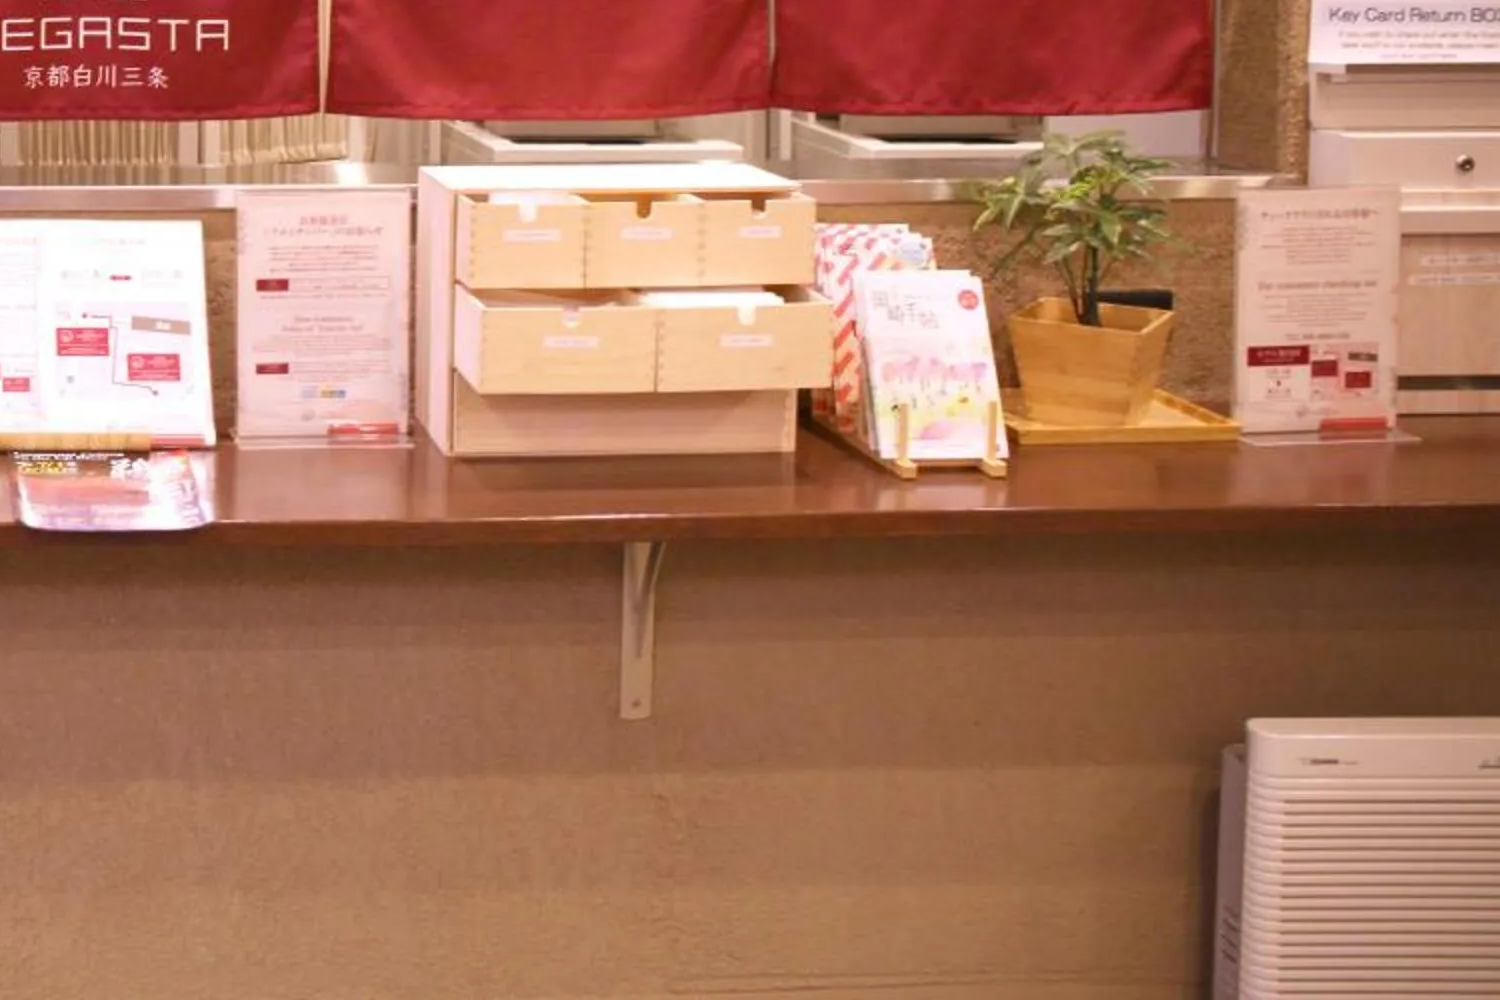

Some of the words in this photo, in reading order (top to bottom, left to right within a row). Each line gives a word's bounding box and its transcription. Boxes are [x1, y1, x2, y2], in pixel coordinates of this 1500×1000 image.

[1328, 8, 1361, 24] Key
[1364, 7, 1405, 23] Card
[1409, 7, 1467, 23] Return
[23, 63, 170, 89] 京都白川三条
